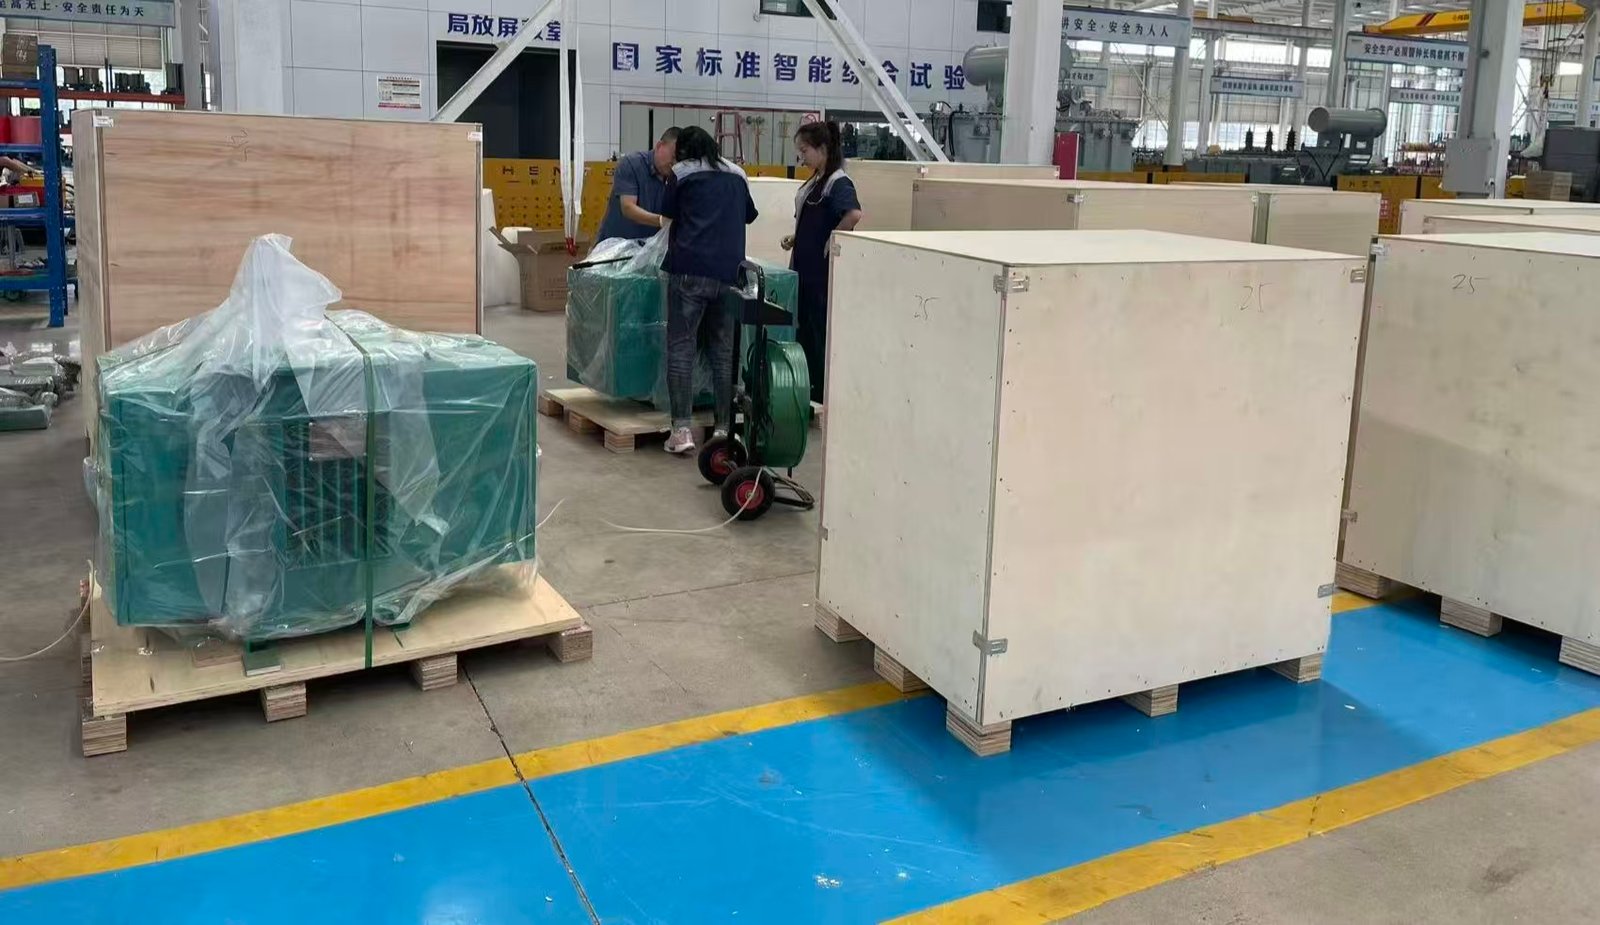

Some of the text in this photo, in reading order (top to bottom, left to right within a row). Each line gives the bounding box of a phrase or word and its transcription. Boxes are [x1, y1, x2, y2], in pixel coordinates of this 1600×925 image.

[447, 13, 561, 42] 局放屏室
[1452, 274, 1489, 295] 25
